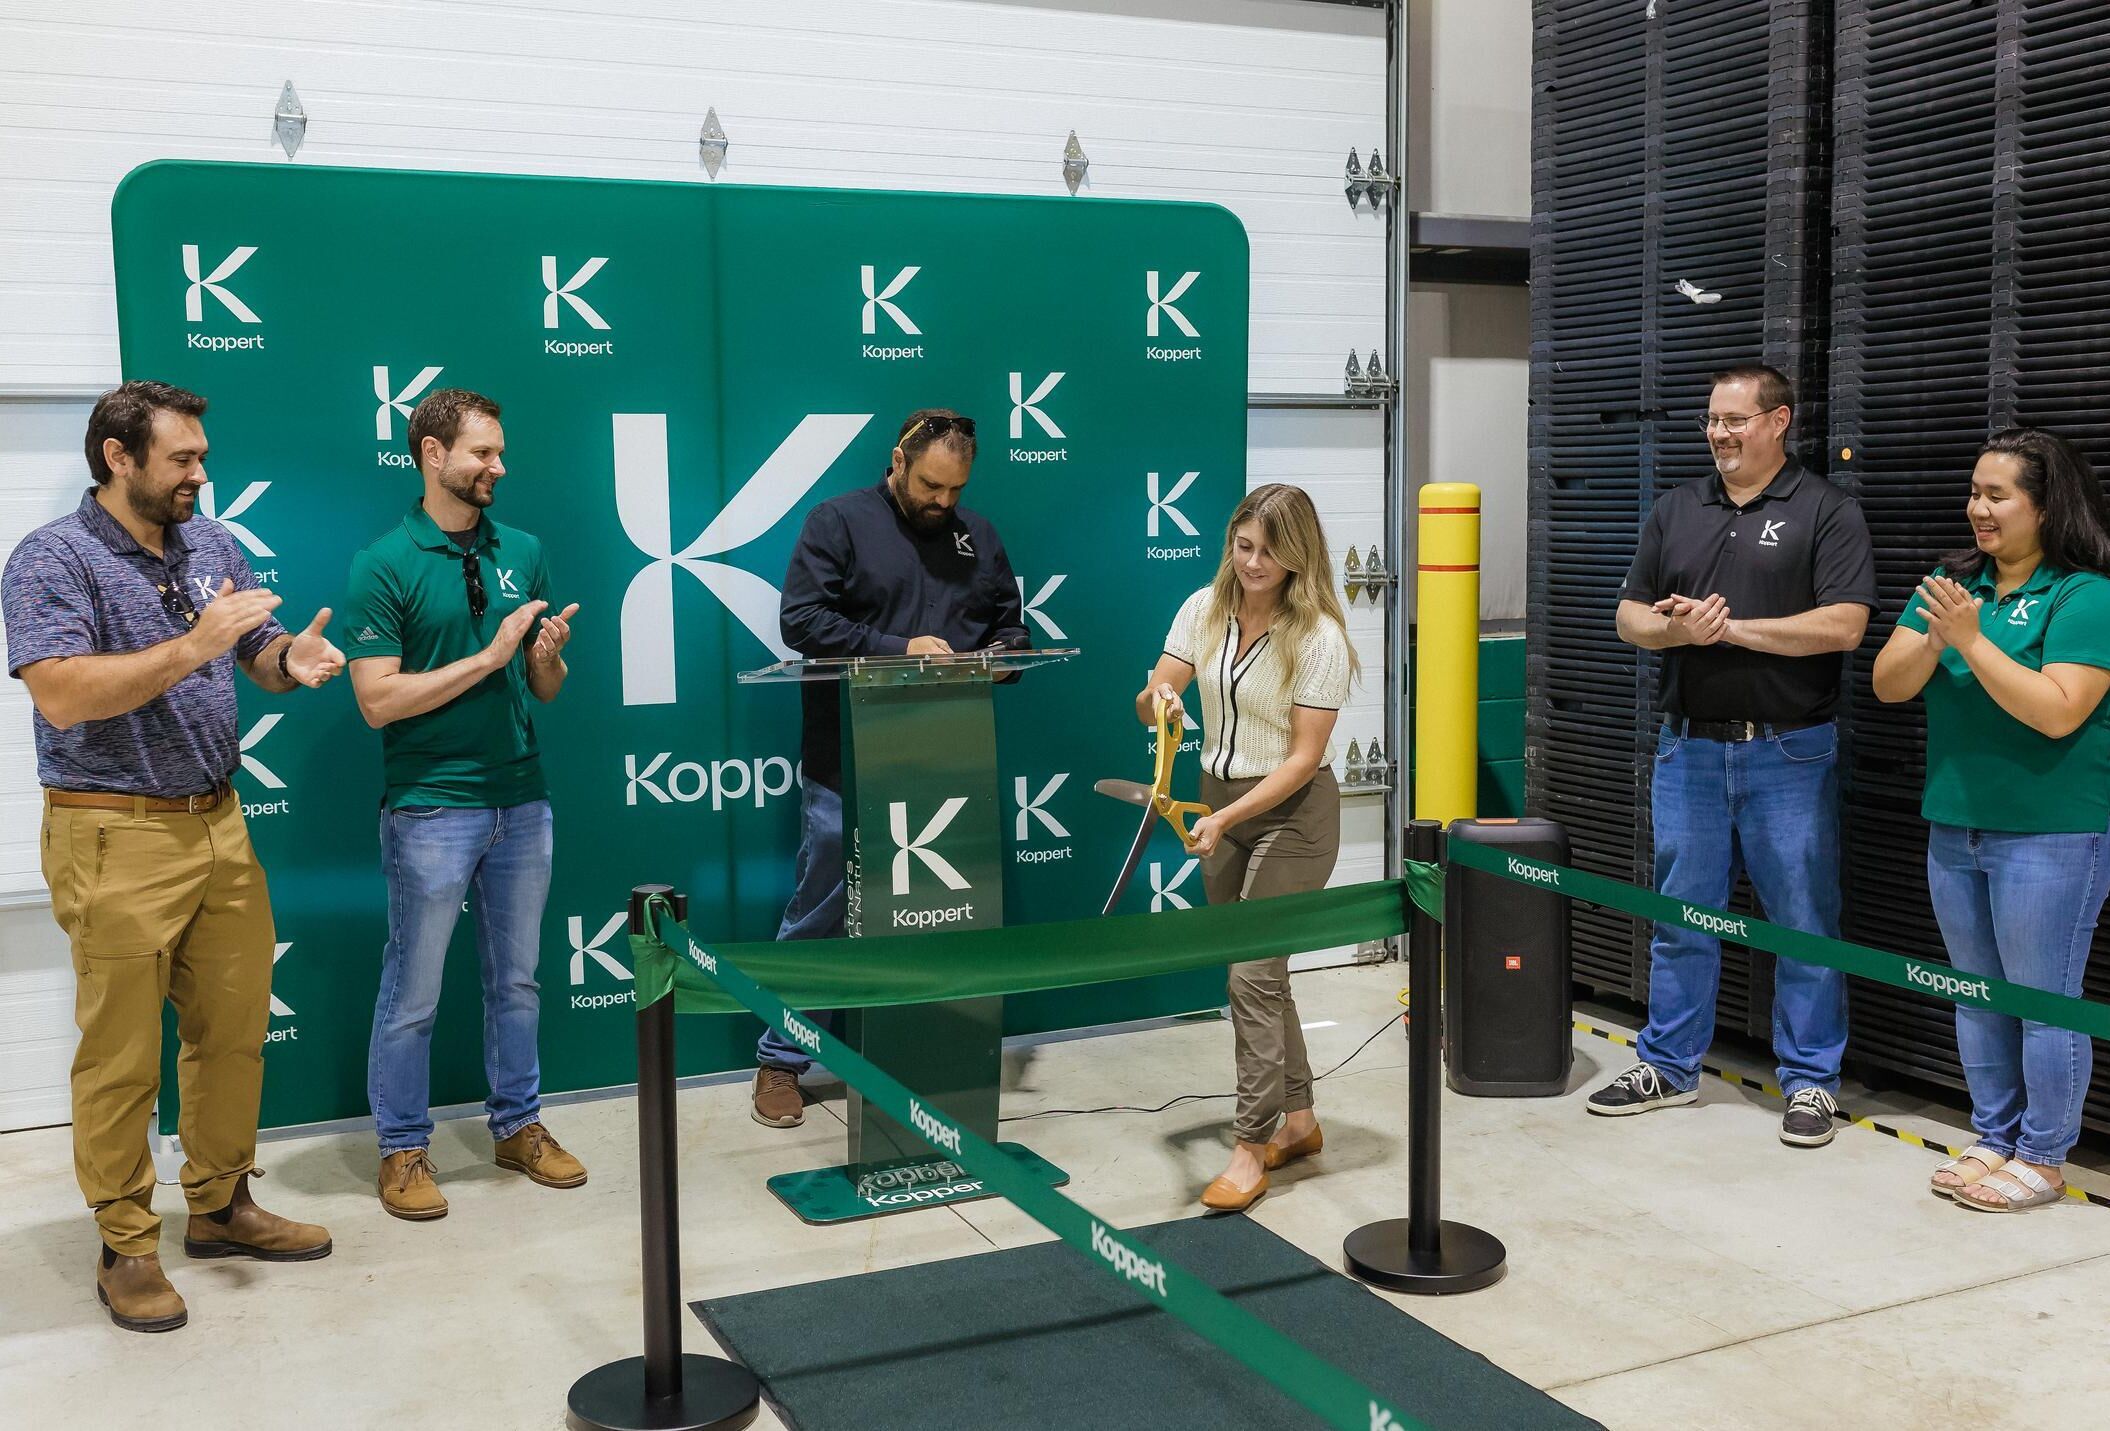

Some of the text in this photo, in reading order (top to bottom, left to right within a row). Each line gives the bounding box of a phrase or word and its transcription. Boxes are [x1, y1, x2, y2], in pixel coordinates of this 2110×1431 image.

[182, 244, 263, 324] K
[541, 255, 612, 330] K
[860, 264, 923, 335] K
[1146, 270, 1201, 338] K
[187, 333, 265, 352] Koppert
[544, 339, 614, 357] Koppert
[862, 344, 924, 361] Koppert
[1146, 346, 1202, 362] Koppert
[372, 365, 445, 441] K
[1009, 371, 1067, 439] K
[1009, 448, 1068, 464] Koppert
[198, 481, 277, 557] K
[1146, 471, 1201, 537] K
[952, 531, 973, 552] K
[1147, 545, 1201, 561] Koppert
[1760, 519, 1786, 541] K
[496, 567, 519, 592] K
[611, 413, 875, 706] K
[1014, 574, 1069, 640] K
[1147, 738, 1201, 755] Kert
[624, 751, 803, 811] Kopp
[1014, 772, 1072, 841] K
[853, 827, 862, 913] Nature
[889, 796, 973, 896] K
[1016, 846, 1073, 864] Koppert
[1508, 857, 1560, 886] Koppert
[846, 860, 855, 939] rtners
[1149, 857, 1200, 914] K
[893, 902, 974, 929] Koppert
[1682, 904, 1748, 939] Koppert
[567, 911, 636, 986] K
[688, 938, 718, 975] Koppert
[571, 989, 637, 1010] Koppert
[1906, 962, 1991, 1003] Koppert
[782, 1008, 821, 1054] Koppert
[909, 1098, 962, 1157] Koppert
[865, 1180, 984, 1207] Kopper
[1090, 1219, 1168, 1298] Koppert
